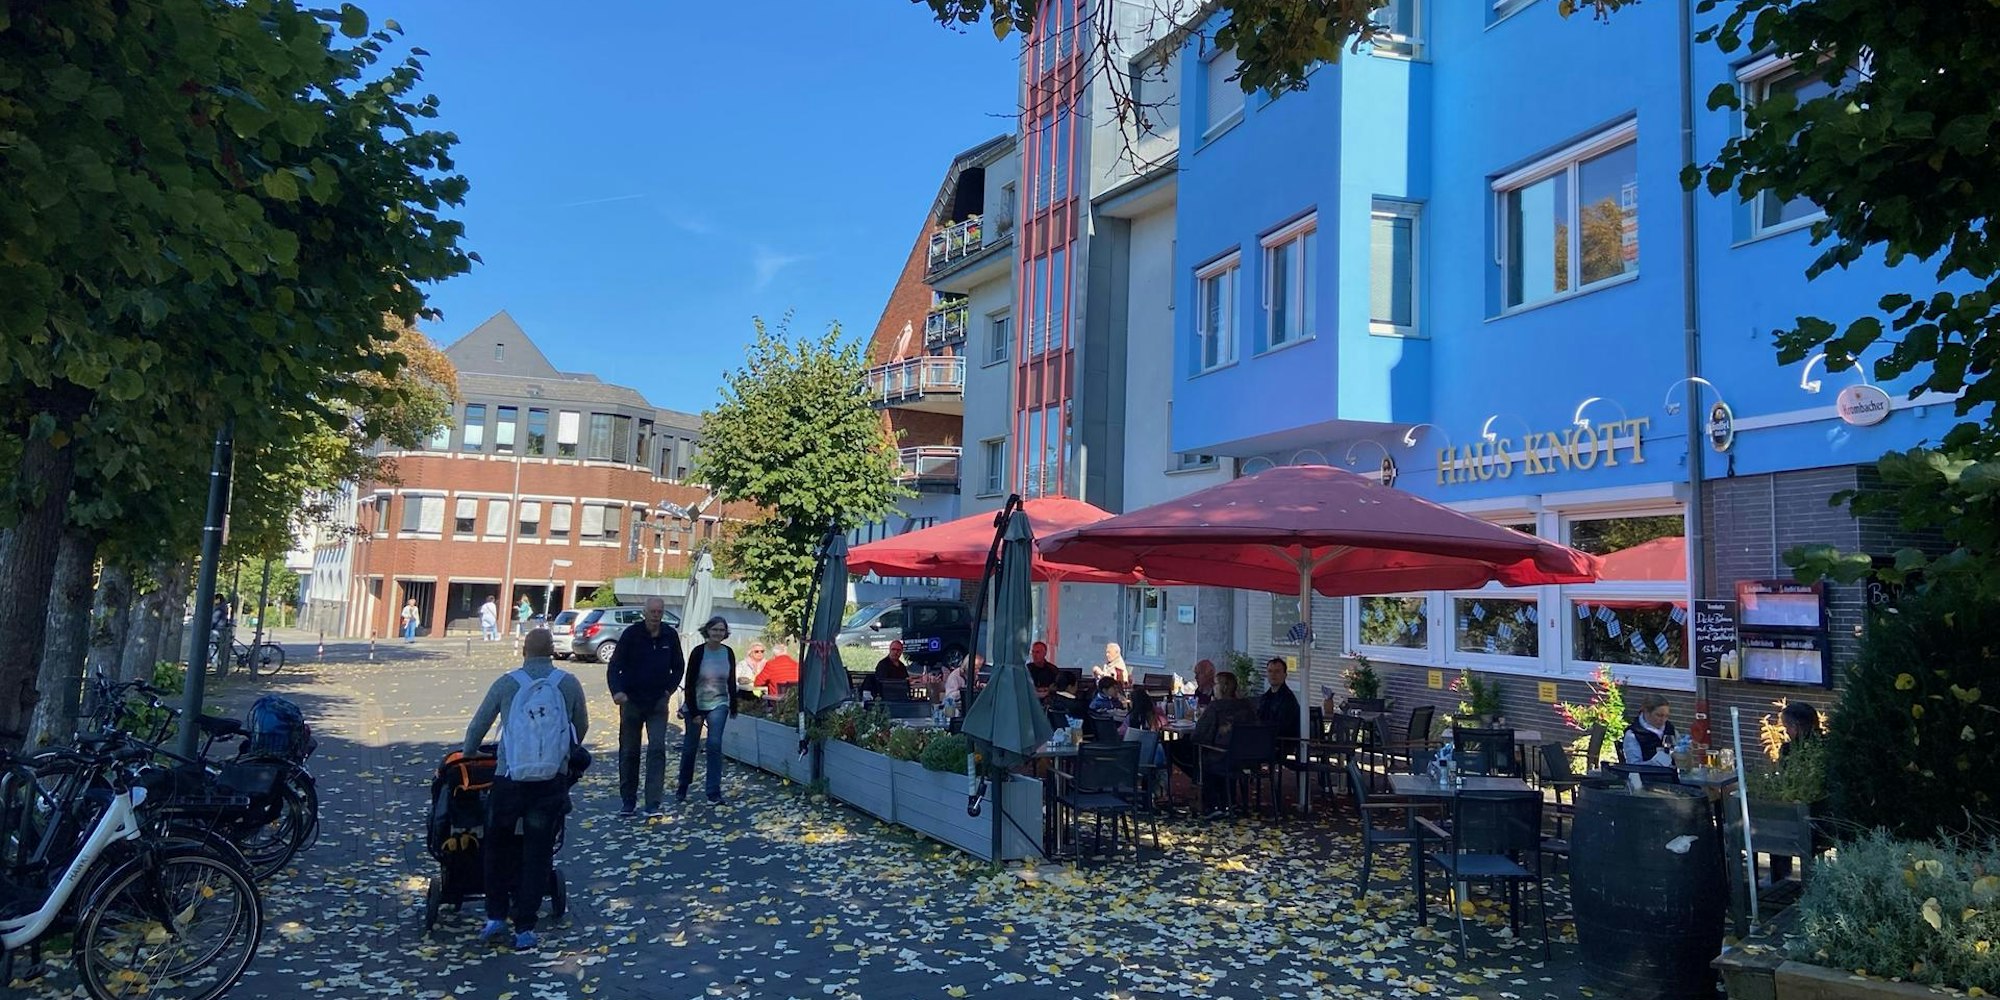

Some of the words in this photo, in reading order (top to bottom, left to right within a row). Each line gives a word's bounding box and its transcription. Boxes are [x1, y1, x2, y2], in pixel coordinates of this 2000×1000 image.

[1841, 400, 1884, 415] Krombacher
[1437, 438, 1512, 485] HAUS
[1523, 416, 1650, 475] KNOTT
